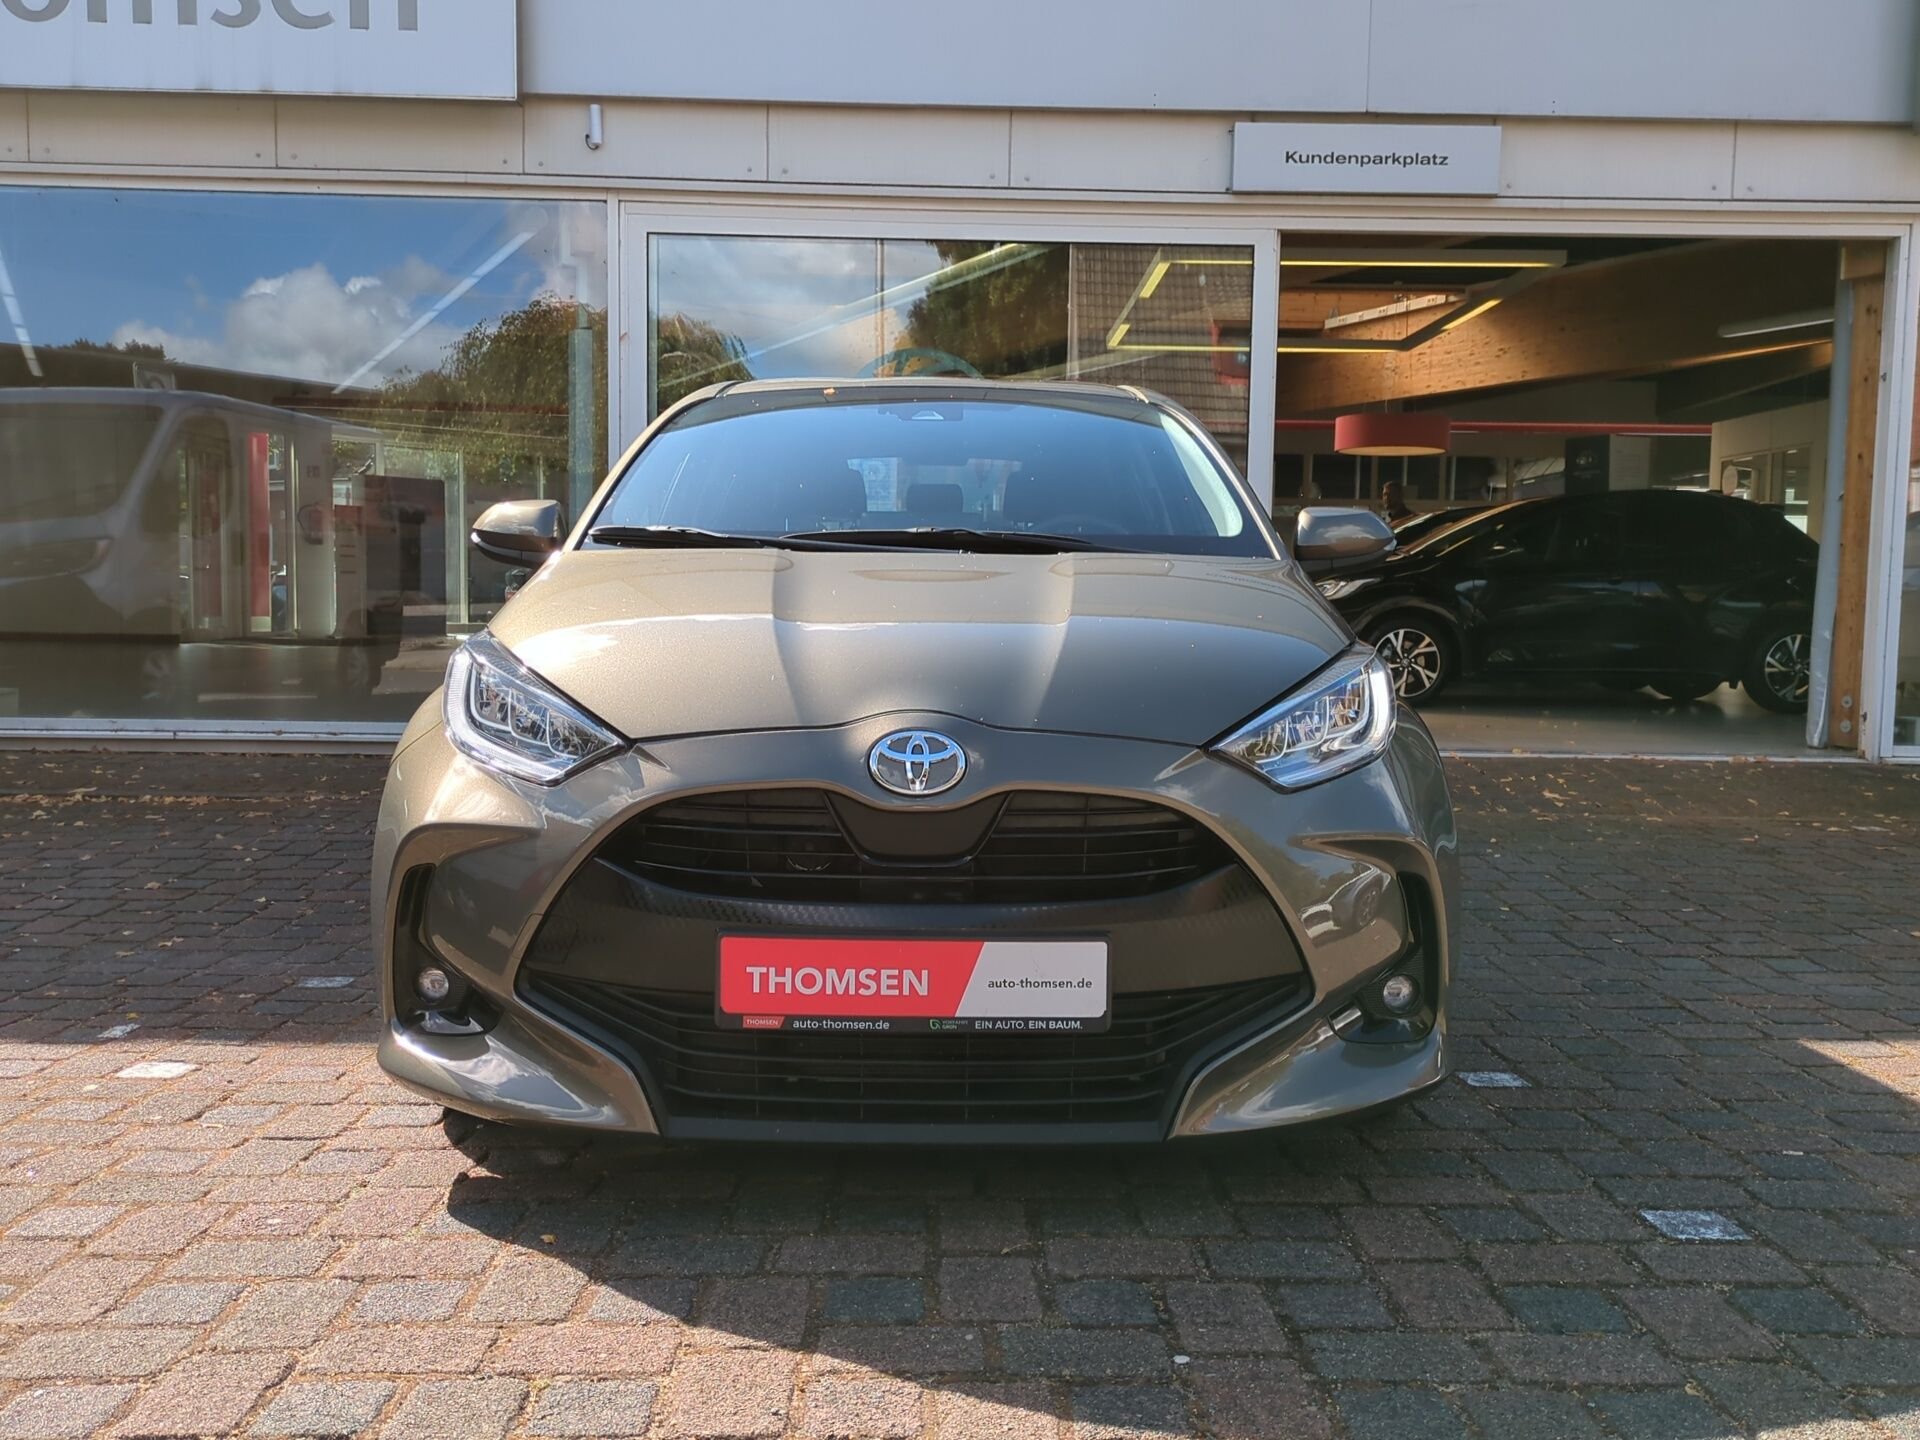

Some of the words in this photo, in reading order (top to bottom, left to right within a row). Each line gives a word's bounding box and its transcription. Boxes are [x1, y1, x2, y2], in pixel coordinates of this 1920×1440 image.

[1285, 150, 1449, 168] Kundenparkplatz
[746, 966, 929, 996] THOMSEN
[987, 977, 1093, 989] auto-thomsen.de
[792, 1019, 890, 1030] auto-thomsen.de
[975, 1020, 993, 1029] EIN
[995, 1020, 1026, 1029] AUTO.
[1028, 1020, 1046, 1029] EIN
[1048, 1020, 1083, 1029] BAUM.
